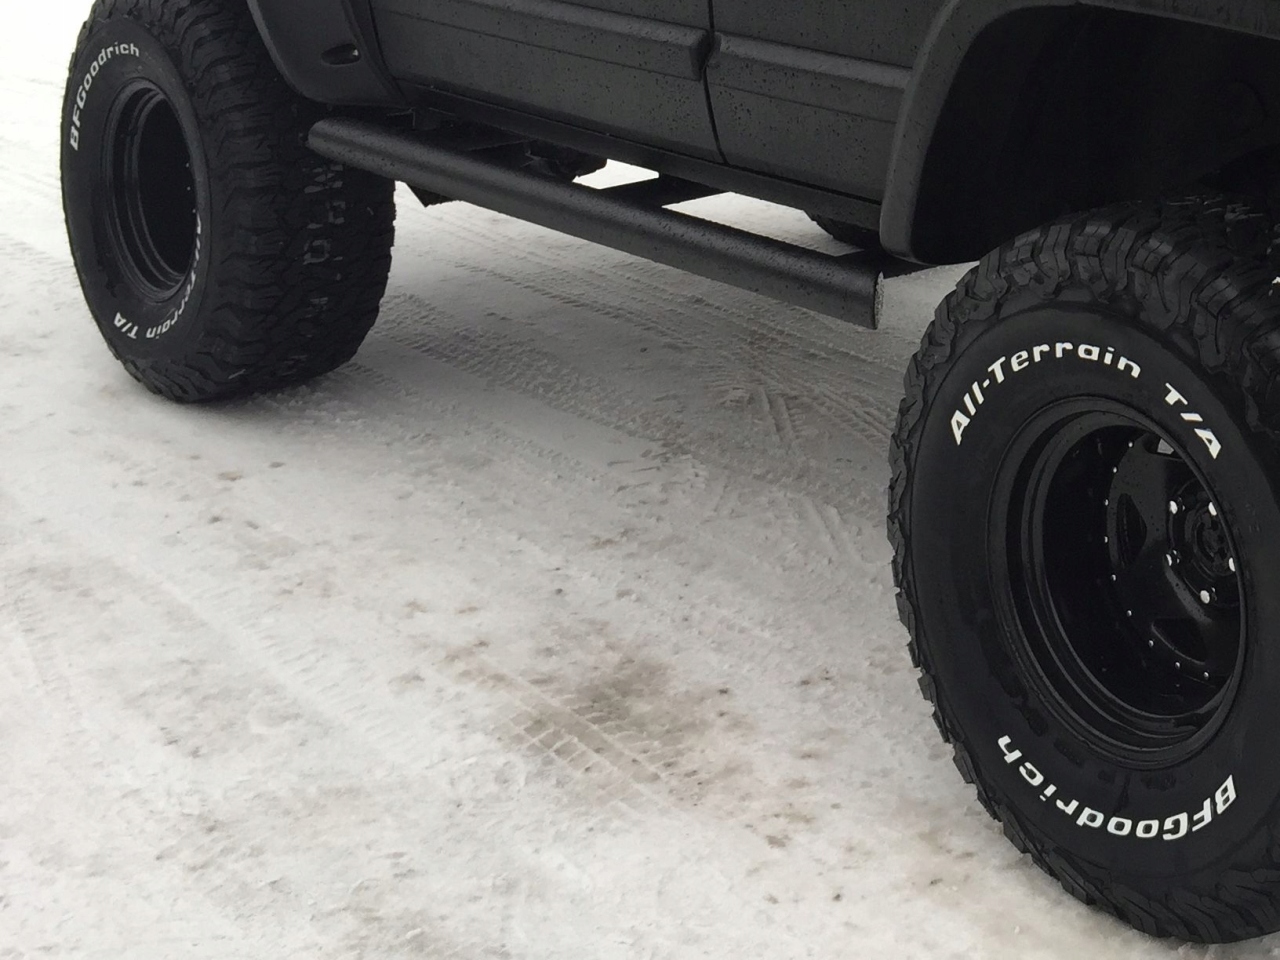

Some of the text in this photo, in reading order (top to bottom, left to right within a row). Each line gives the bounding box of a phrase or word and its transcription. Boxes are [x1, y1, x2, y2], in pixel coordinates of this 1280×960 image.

[69, 41, 140, 151] BFGoodrich
[114, 312, 138, 339] T/A
[950, 341, 1222, 460] All-Terrain T/A
[997, 734, 1238, 841] BFGoodrich
